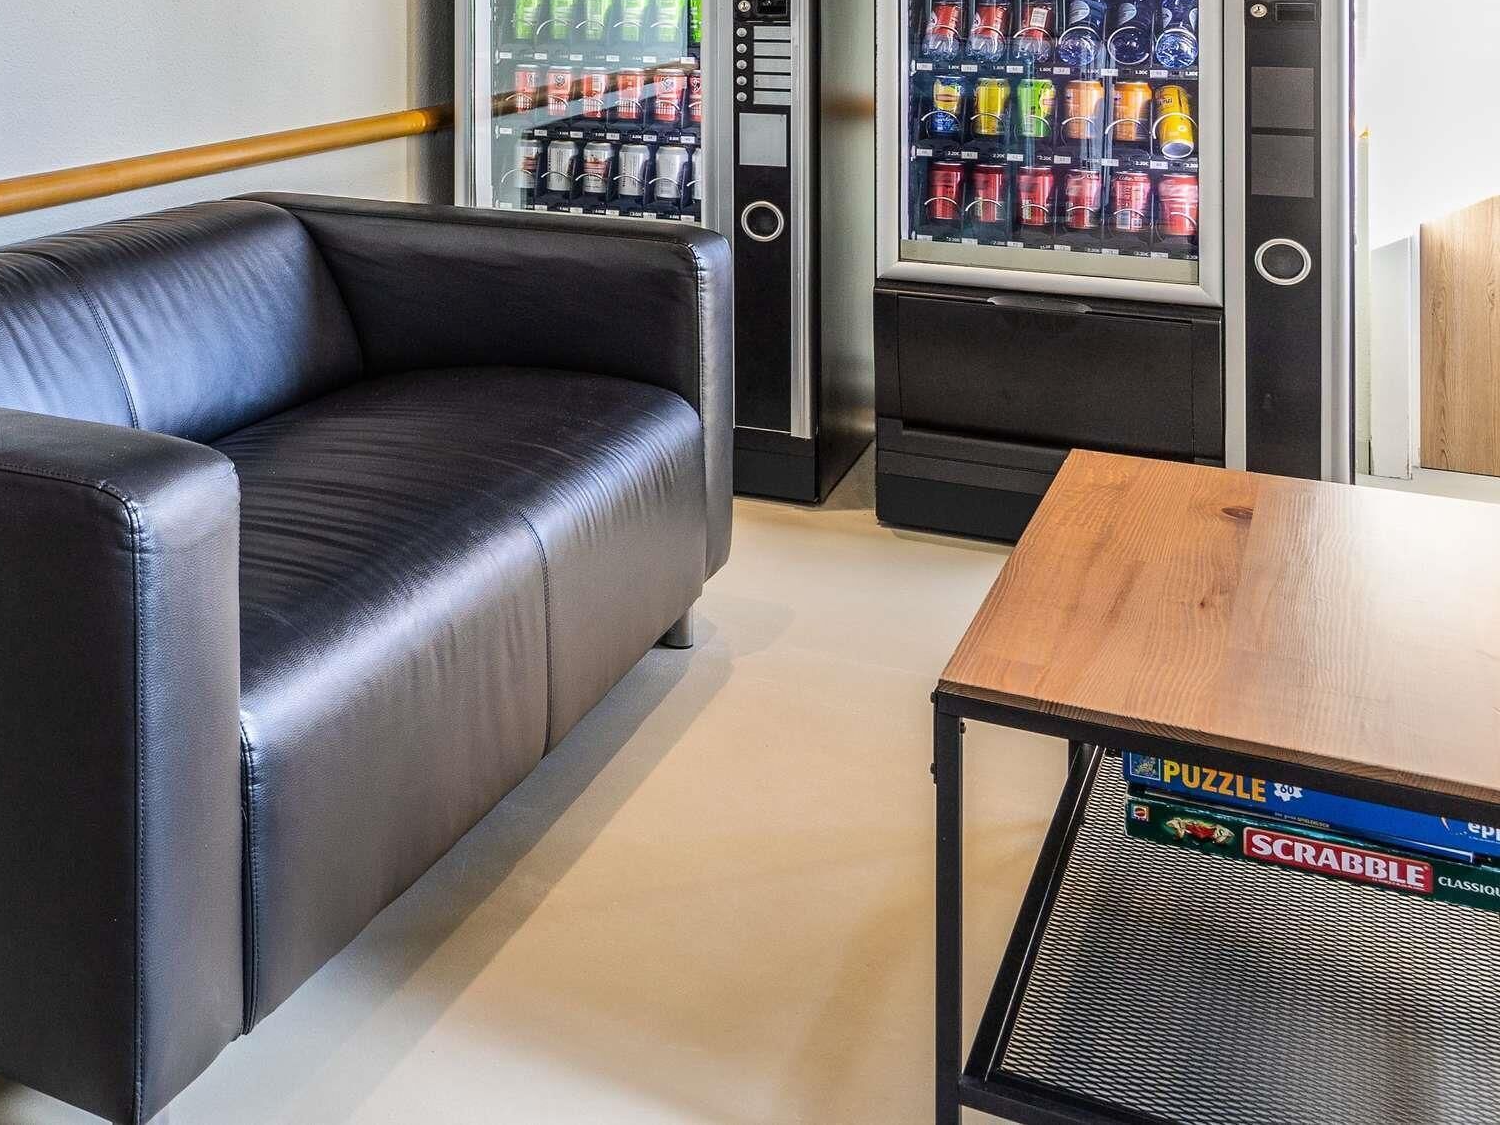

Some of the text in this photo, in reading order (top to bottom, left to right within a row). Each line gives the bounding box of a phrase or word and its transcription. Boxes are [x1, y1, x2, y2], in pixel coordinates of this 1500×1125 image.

[1163, 760, 1267, 803] PUZZLE
[1280, 783, 1295, 796] 60
[1251, 834, 1426, 889] SCRABBLE
